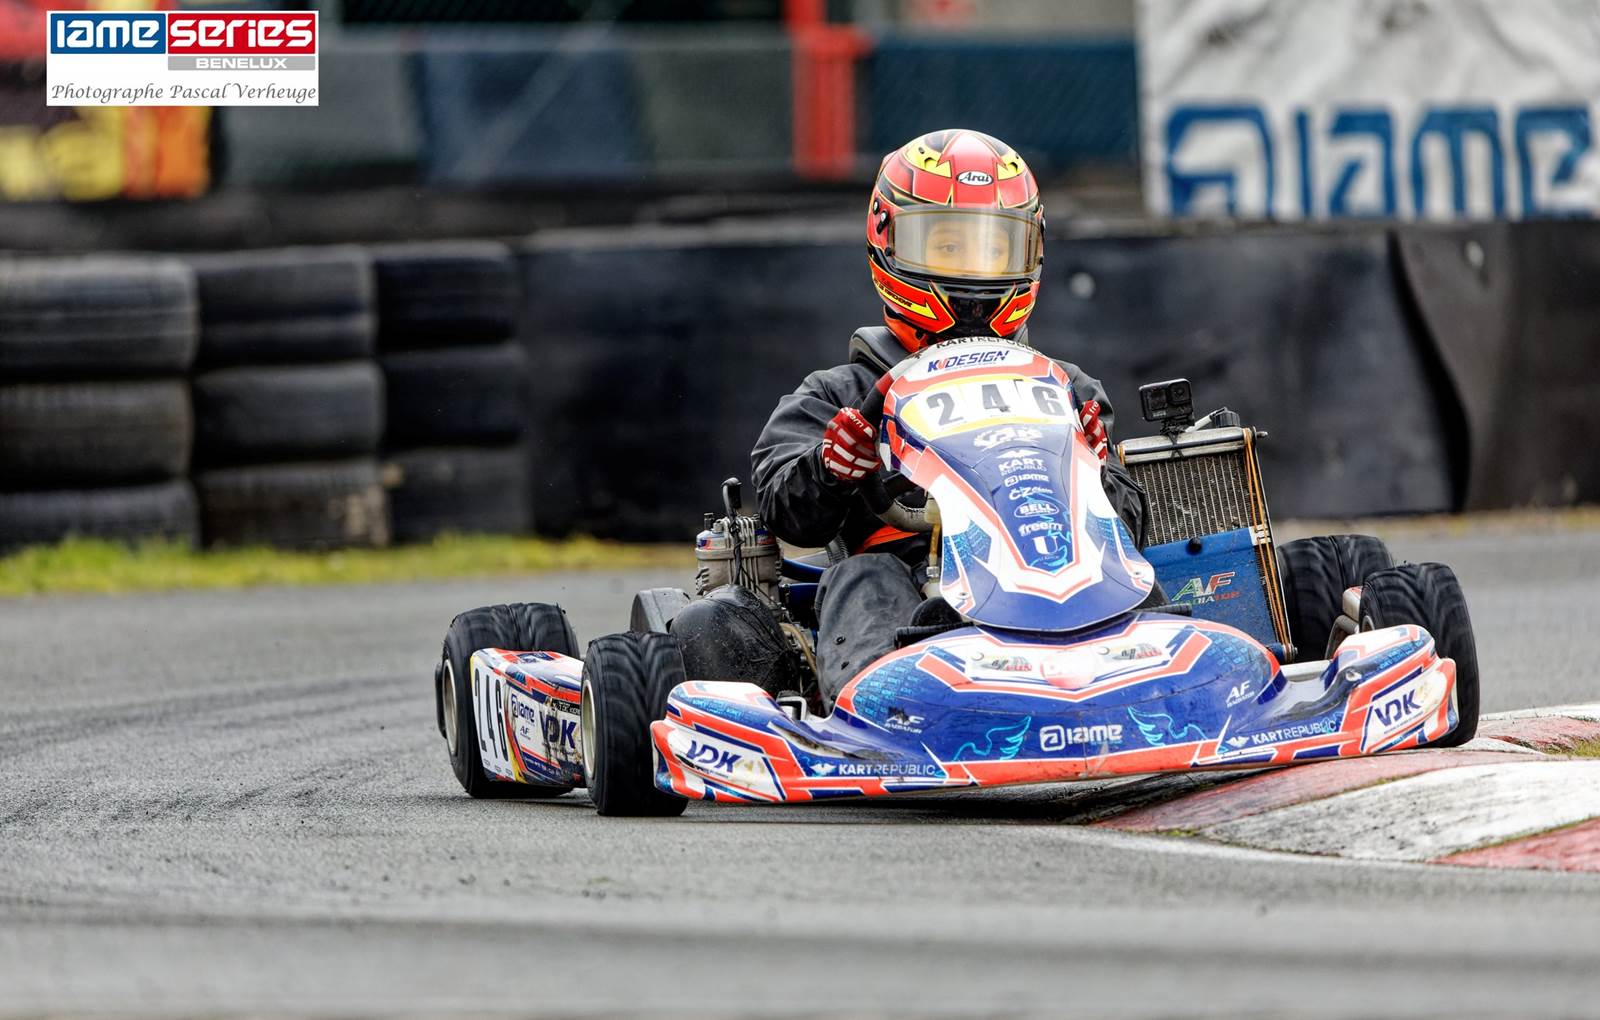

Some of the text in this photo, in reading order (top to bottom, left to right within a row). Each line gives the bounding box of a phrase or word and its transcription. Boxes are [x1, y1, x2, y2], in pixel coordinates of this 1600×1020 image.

[957, 172, 991, 184] Arai
[998, 458, 1044, 472] KART
[1020, 503, 1057, 514] BELL
[1018, 522, 1063, 537] freem
[1226, 680, 1251, 704] AF
[1374, 688, 1422, 727] VDK
[687, 739, 742, 773] VDK
